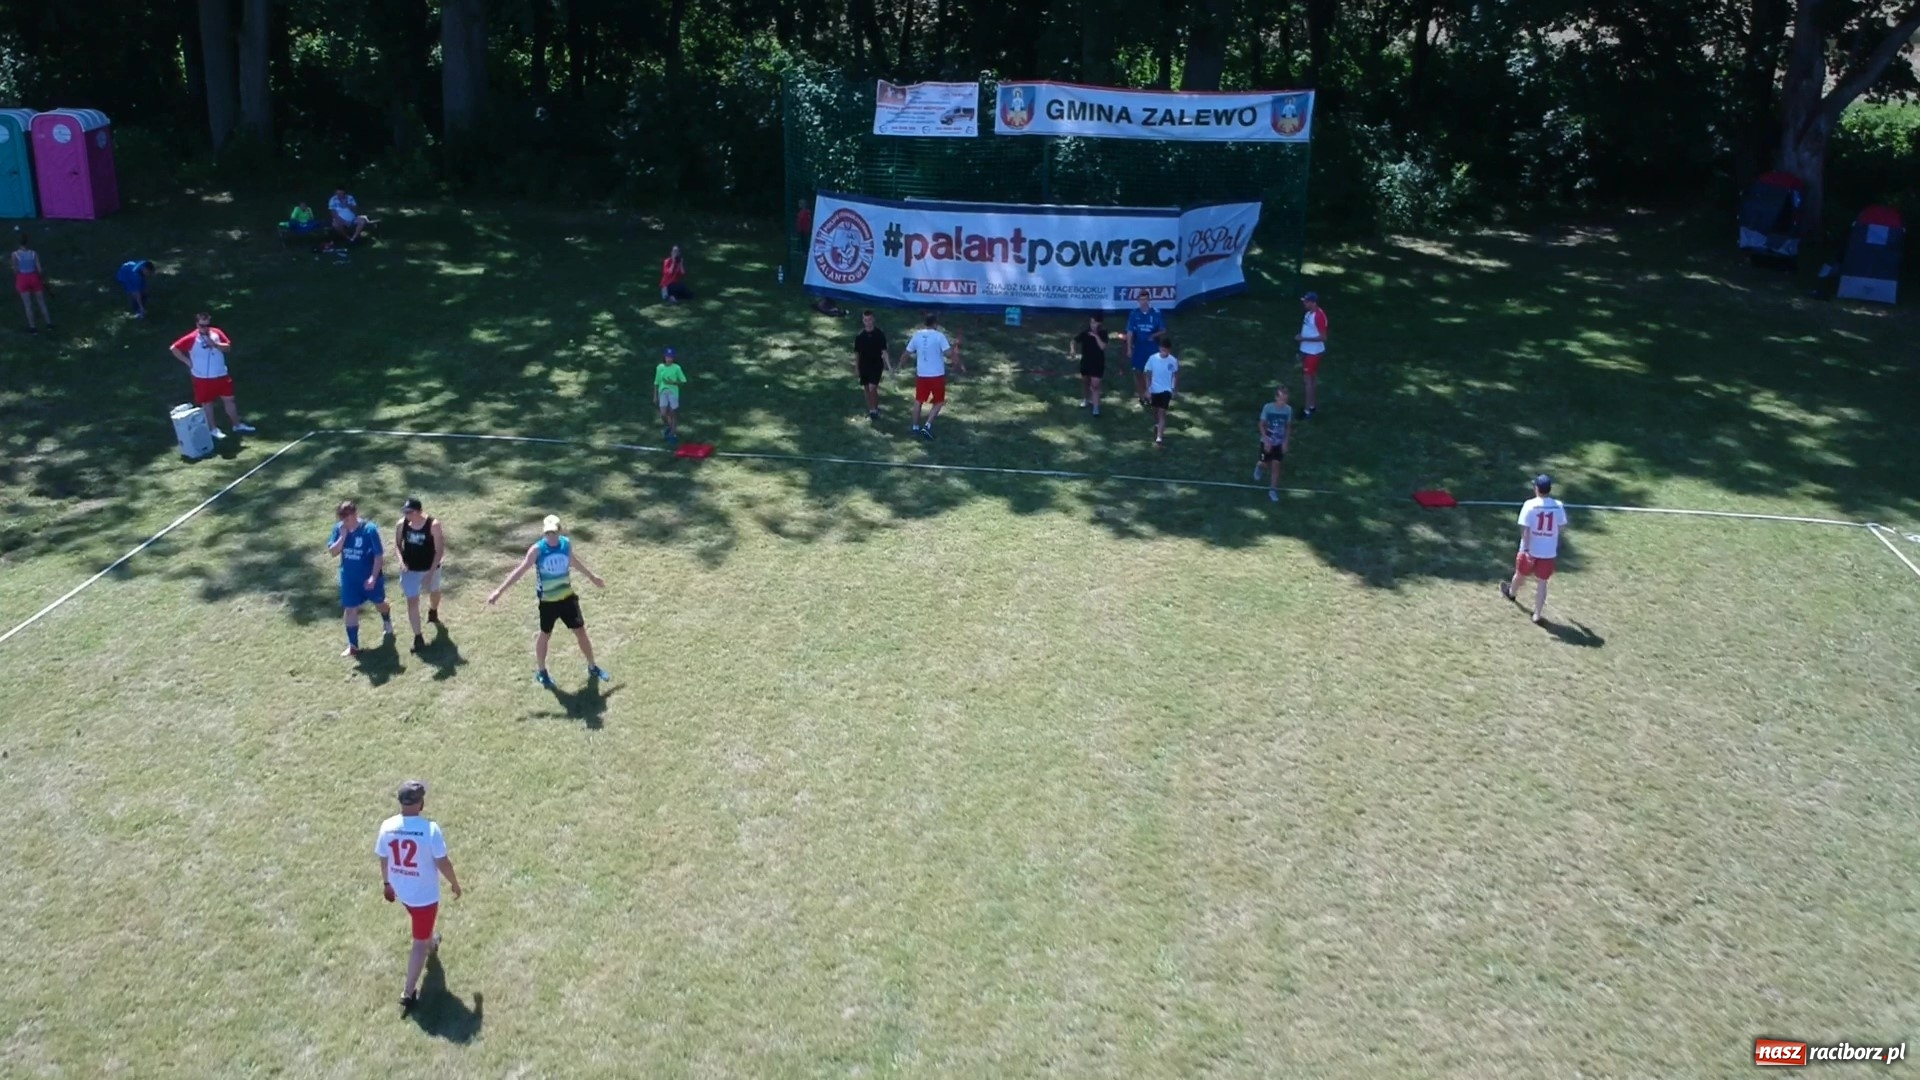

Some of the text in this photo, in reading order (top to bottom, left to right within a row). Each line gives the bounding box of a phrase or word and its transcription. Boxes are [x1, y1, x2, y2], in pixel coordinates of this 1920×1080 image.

[1045, 99, 1259, 128] GMINA ZALEWO
[1536, 512, 1553, 530] 11
[388, 839, 417, 867] 12
